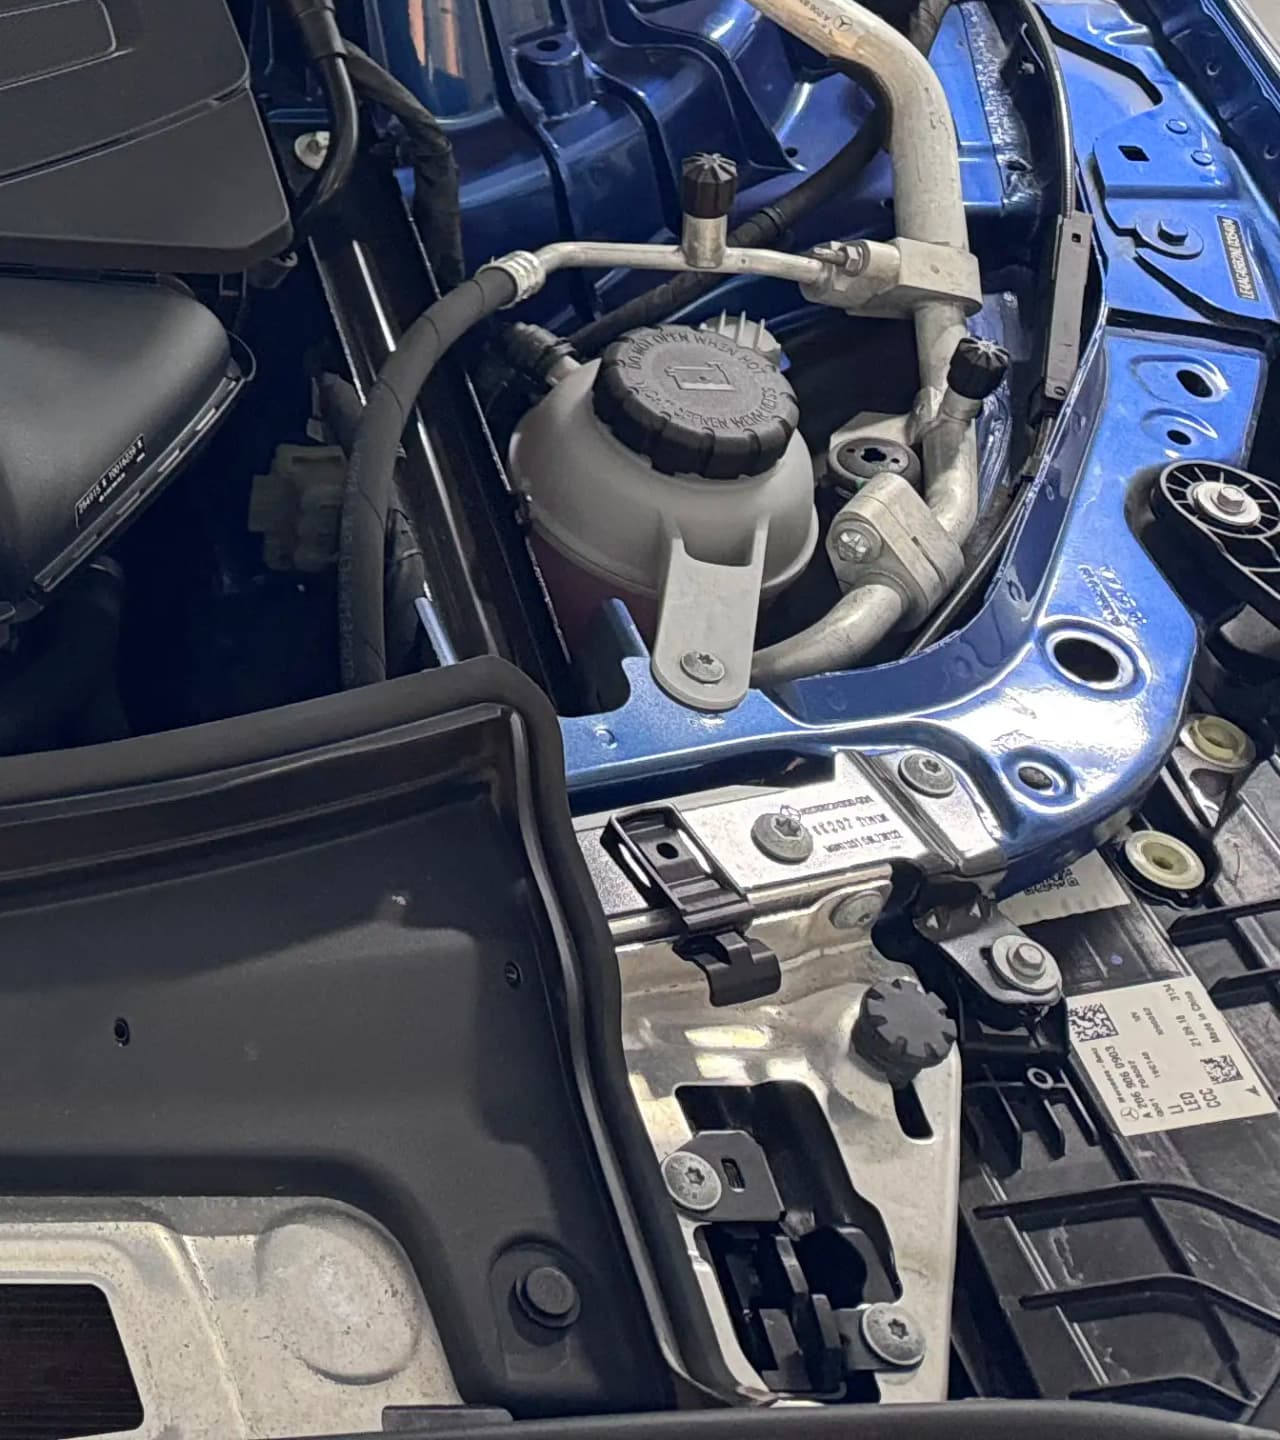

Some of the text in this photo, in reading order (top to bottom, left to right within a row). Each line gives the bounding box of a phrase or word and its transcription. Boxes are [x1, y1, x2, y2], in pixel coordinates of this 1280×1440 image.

[653, 333, 691, 346] OPEN
[694, 334, 740, 356] WHEN
[1198, 1013, 1207, 1021] in
[1203, 1023, 1221, 1043] Made
[1105, 1045, 1125, 1069] 0903
[1119, 1071, 1136, 1089] 906
[1130, 1091, 1148, 1110] 206
[1179, 1091, 1202, 1112] LED
[1198, 1087, 1221, 1108] CCC
